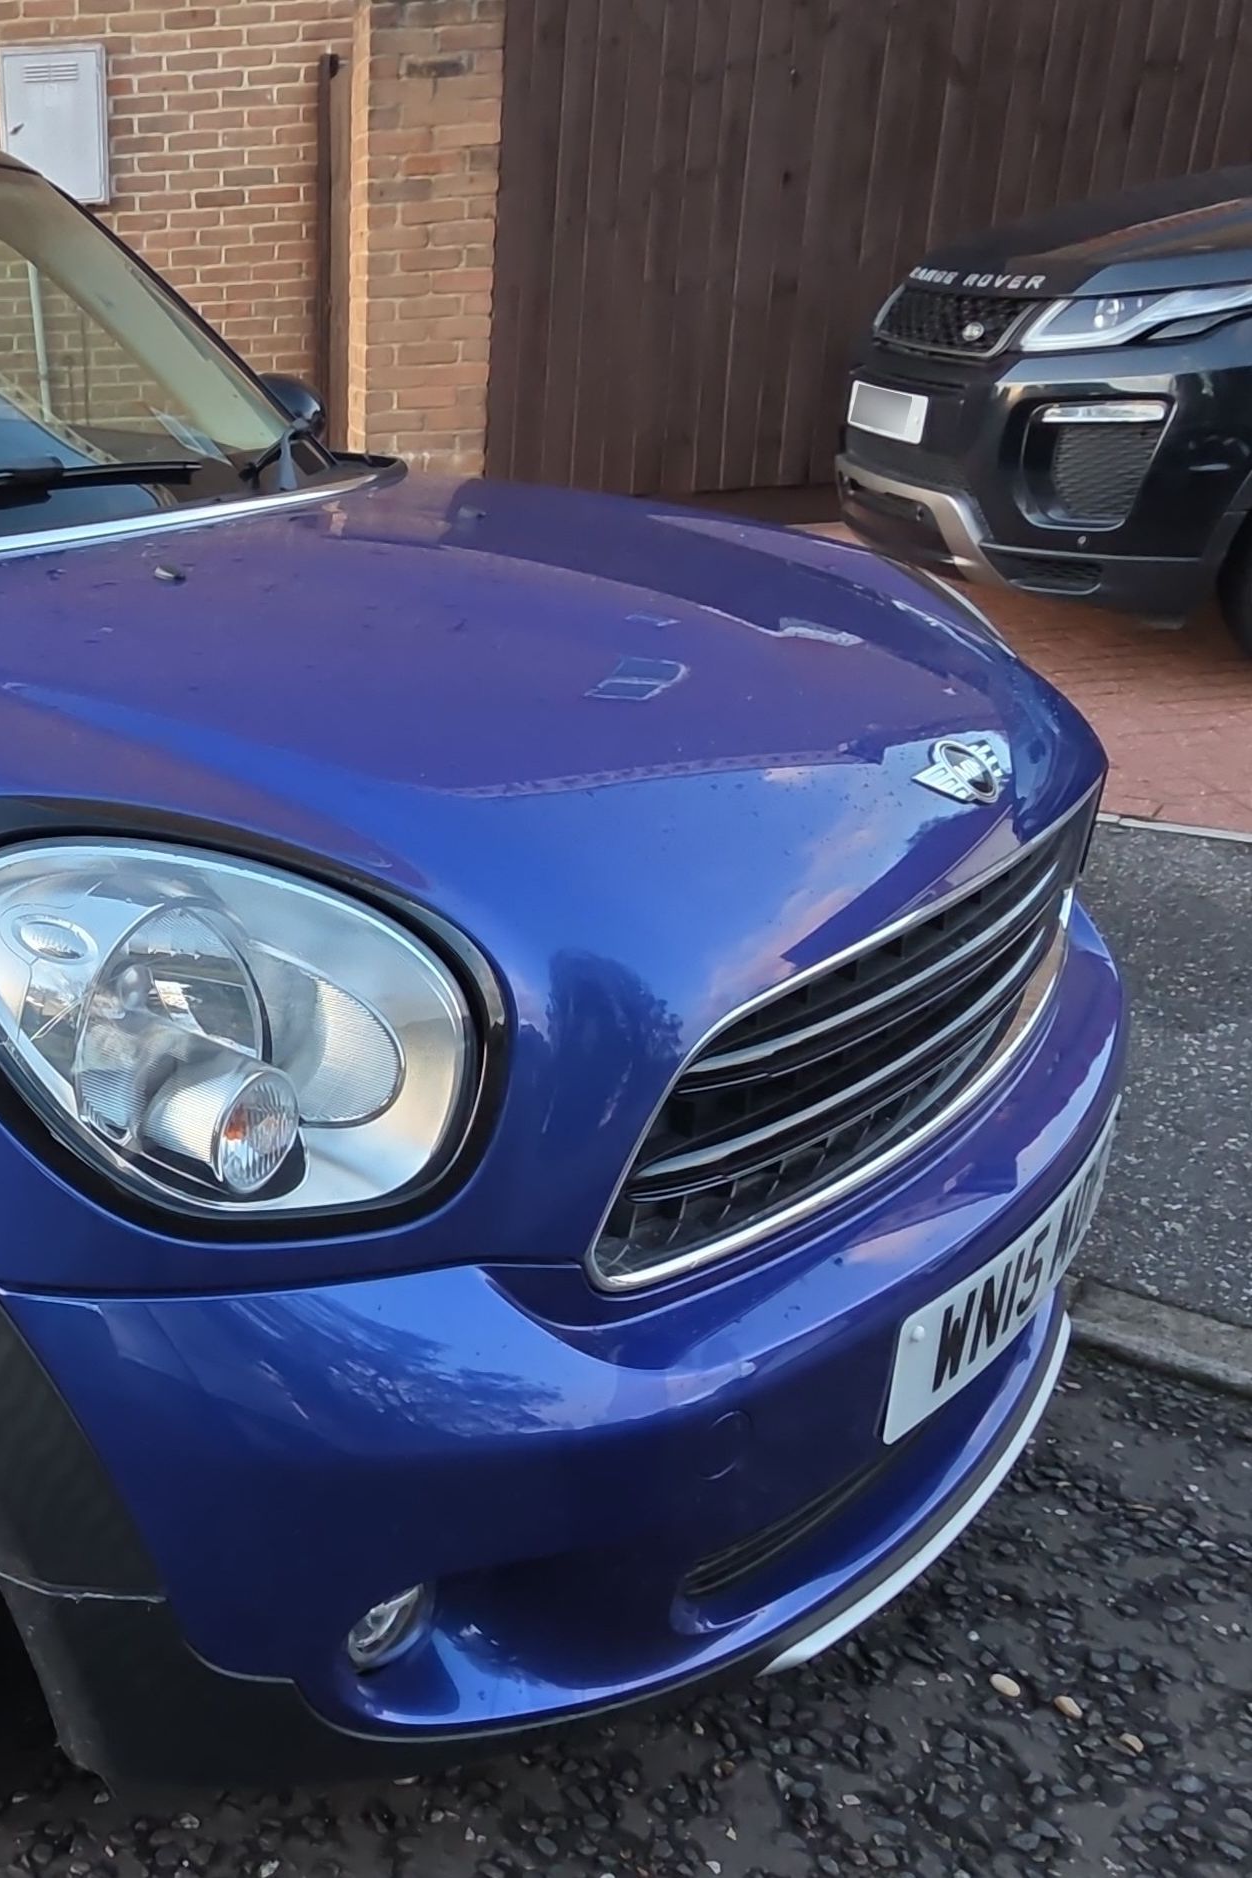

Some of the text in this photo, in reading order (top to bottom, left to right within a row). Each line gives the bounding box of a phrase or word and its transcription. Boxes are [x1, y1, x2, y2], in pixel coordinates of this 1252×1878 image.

[909, 266, 1046, 289] RANGE ROVER
[932, 1221, 1051, 1393] WN15
